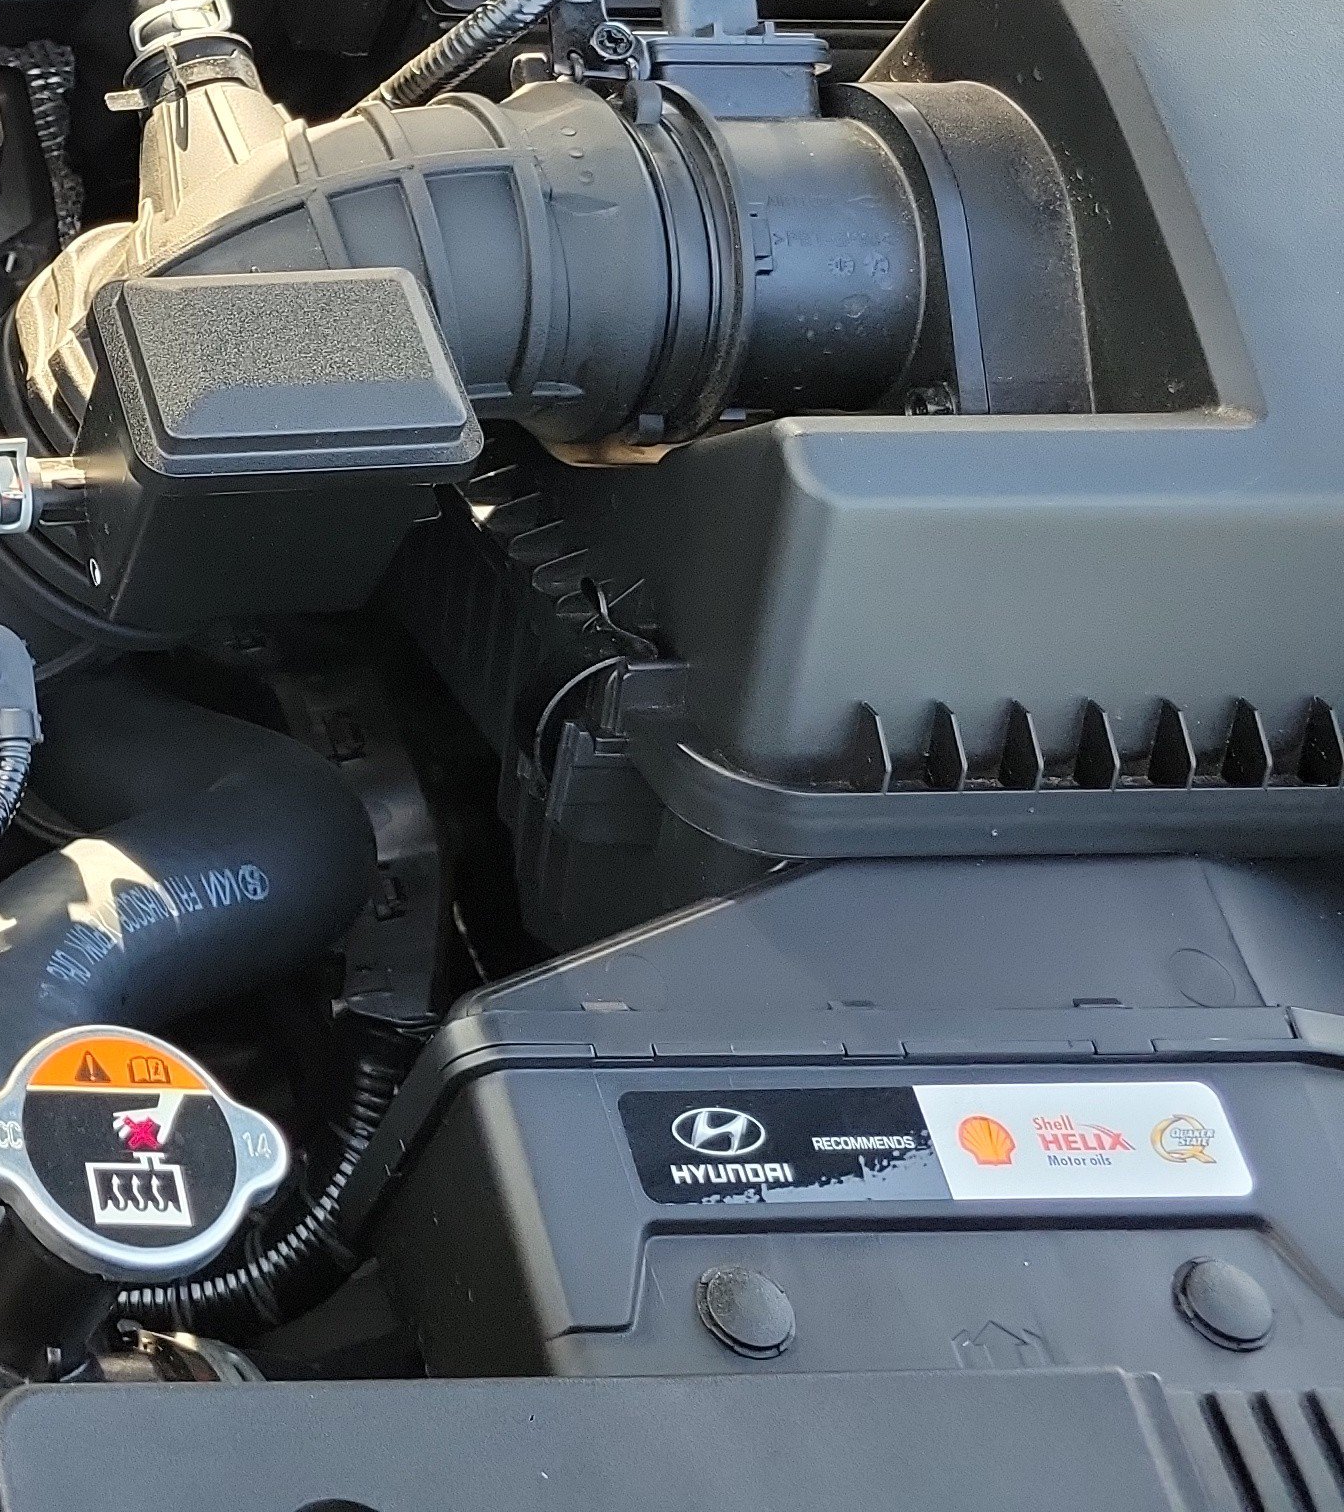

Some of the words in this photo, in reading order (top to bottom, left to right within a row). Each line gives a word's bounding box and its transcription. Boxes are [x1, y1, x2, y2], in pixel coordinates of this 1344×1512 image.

[1032, 1114, 1075, 1131] Shell
[1169, 1127, 1216, 1139] QUAKER
[1037, 1132, 1134, 1151] HELIX
[1177, 1137, 1210, 1147] STATE
[669, 1161, 795, 1185] HYUNDAI
[811, 1135, 916, 1151] RECOMMENDS
[1046, 1154, 1087, 1167] Motor
[1089, 1153, 1112, 1166] oils
